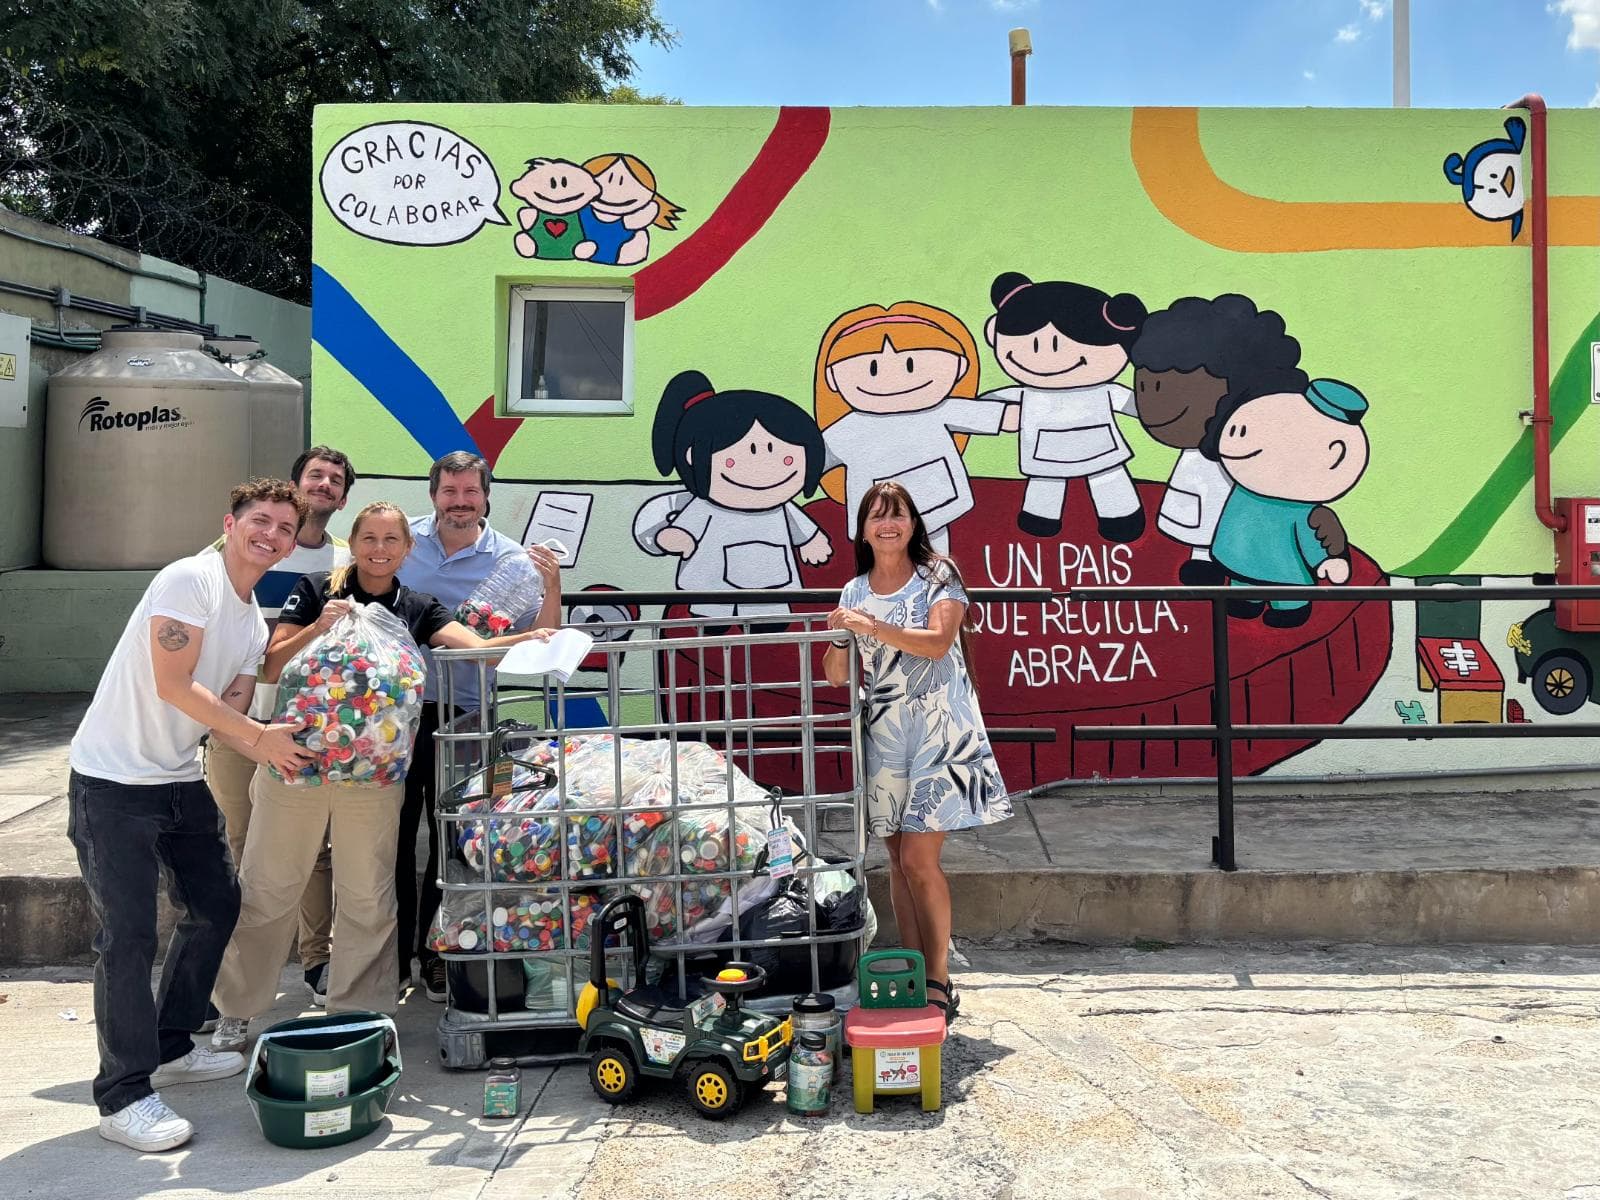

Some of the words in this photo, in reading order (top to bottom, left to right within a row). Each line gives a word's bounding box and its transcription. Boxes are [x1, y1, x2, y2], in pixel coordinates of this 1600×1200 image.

[341, 131, 482, 178] GRACIAS
[393, 173, 426, 189] POR
[339, 193, 484, 226] COLABORAR
[90, 405, 181, 432] Rotoplas
[984, 542, 1043, 587] UN
[1059, 542, 1133, 586] PAIS
[964, 600, 1029, 636] QUE
[1041, 597, 1189, 635] RECICLA,
[1008, 641, 1157, 687] ABRAZA
